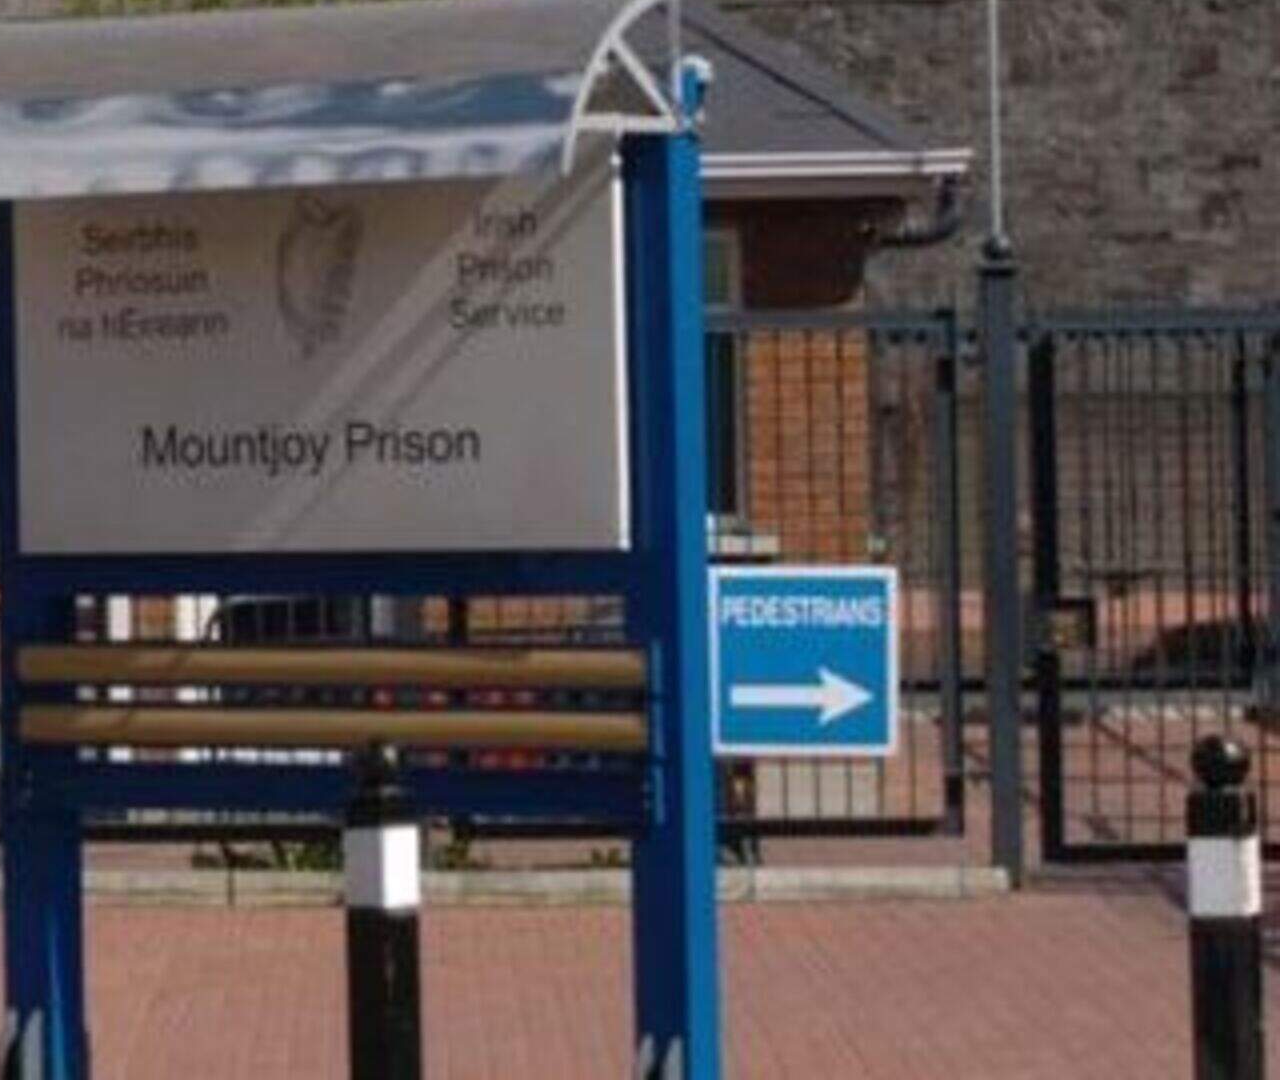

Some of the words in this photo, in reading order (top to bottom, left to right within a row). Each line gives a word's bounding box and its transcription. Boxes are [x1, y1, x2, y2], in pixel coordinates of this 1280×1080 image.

[456, 252, 554, 286] Prison
[449, 297, 566, 330] Service
[143, 424, 330, 476] Mountjoy
[345, 421, 481, 464] Prison
[722, 595, 883, 627] PEDESTRIANS
